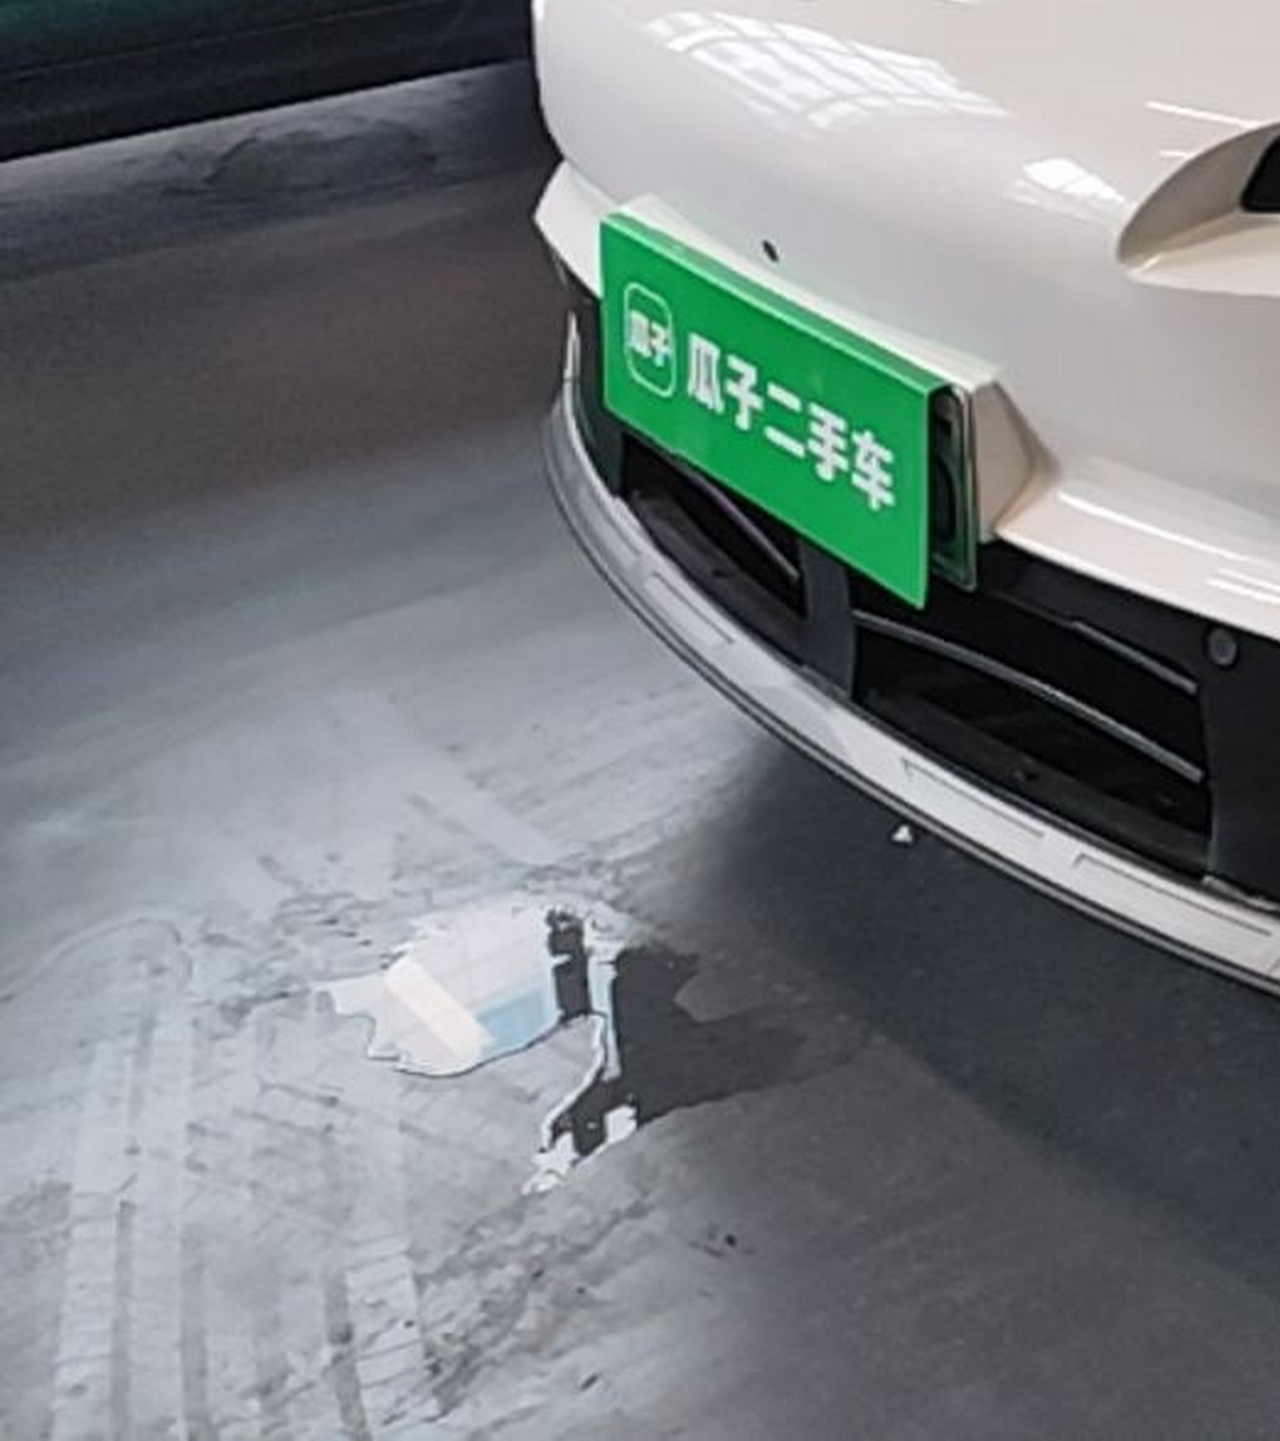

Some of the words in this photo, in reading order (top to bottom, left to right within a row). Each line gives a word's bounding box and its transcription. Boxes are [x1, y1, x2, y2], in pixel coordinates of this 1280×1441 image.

[687, 332, 896, 511] 瓜子二手车
